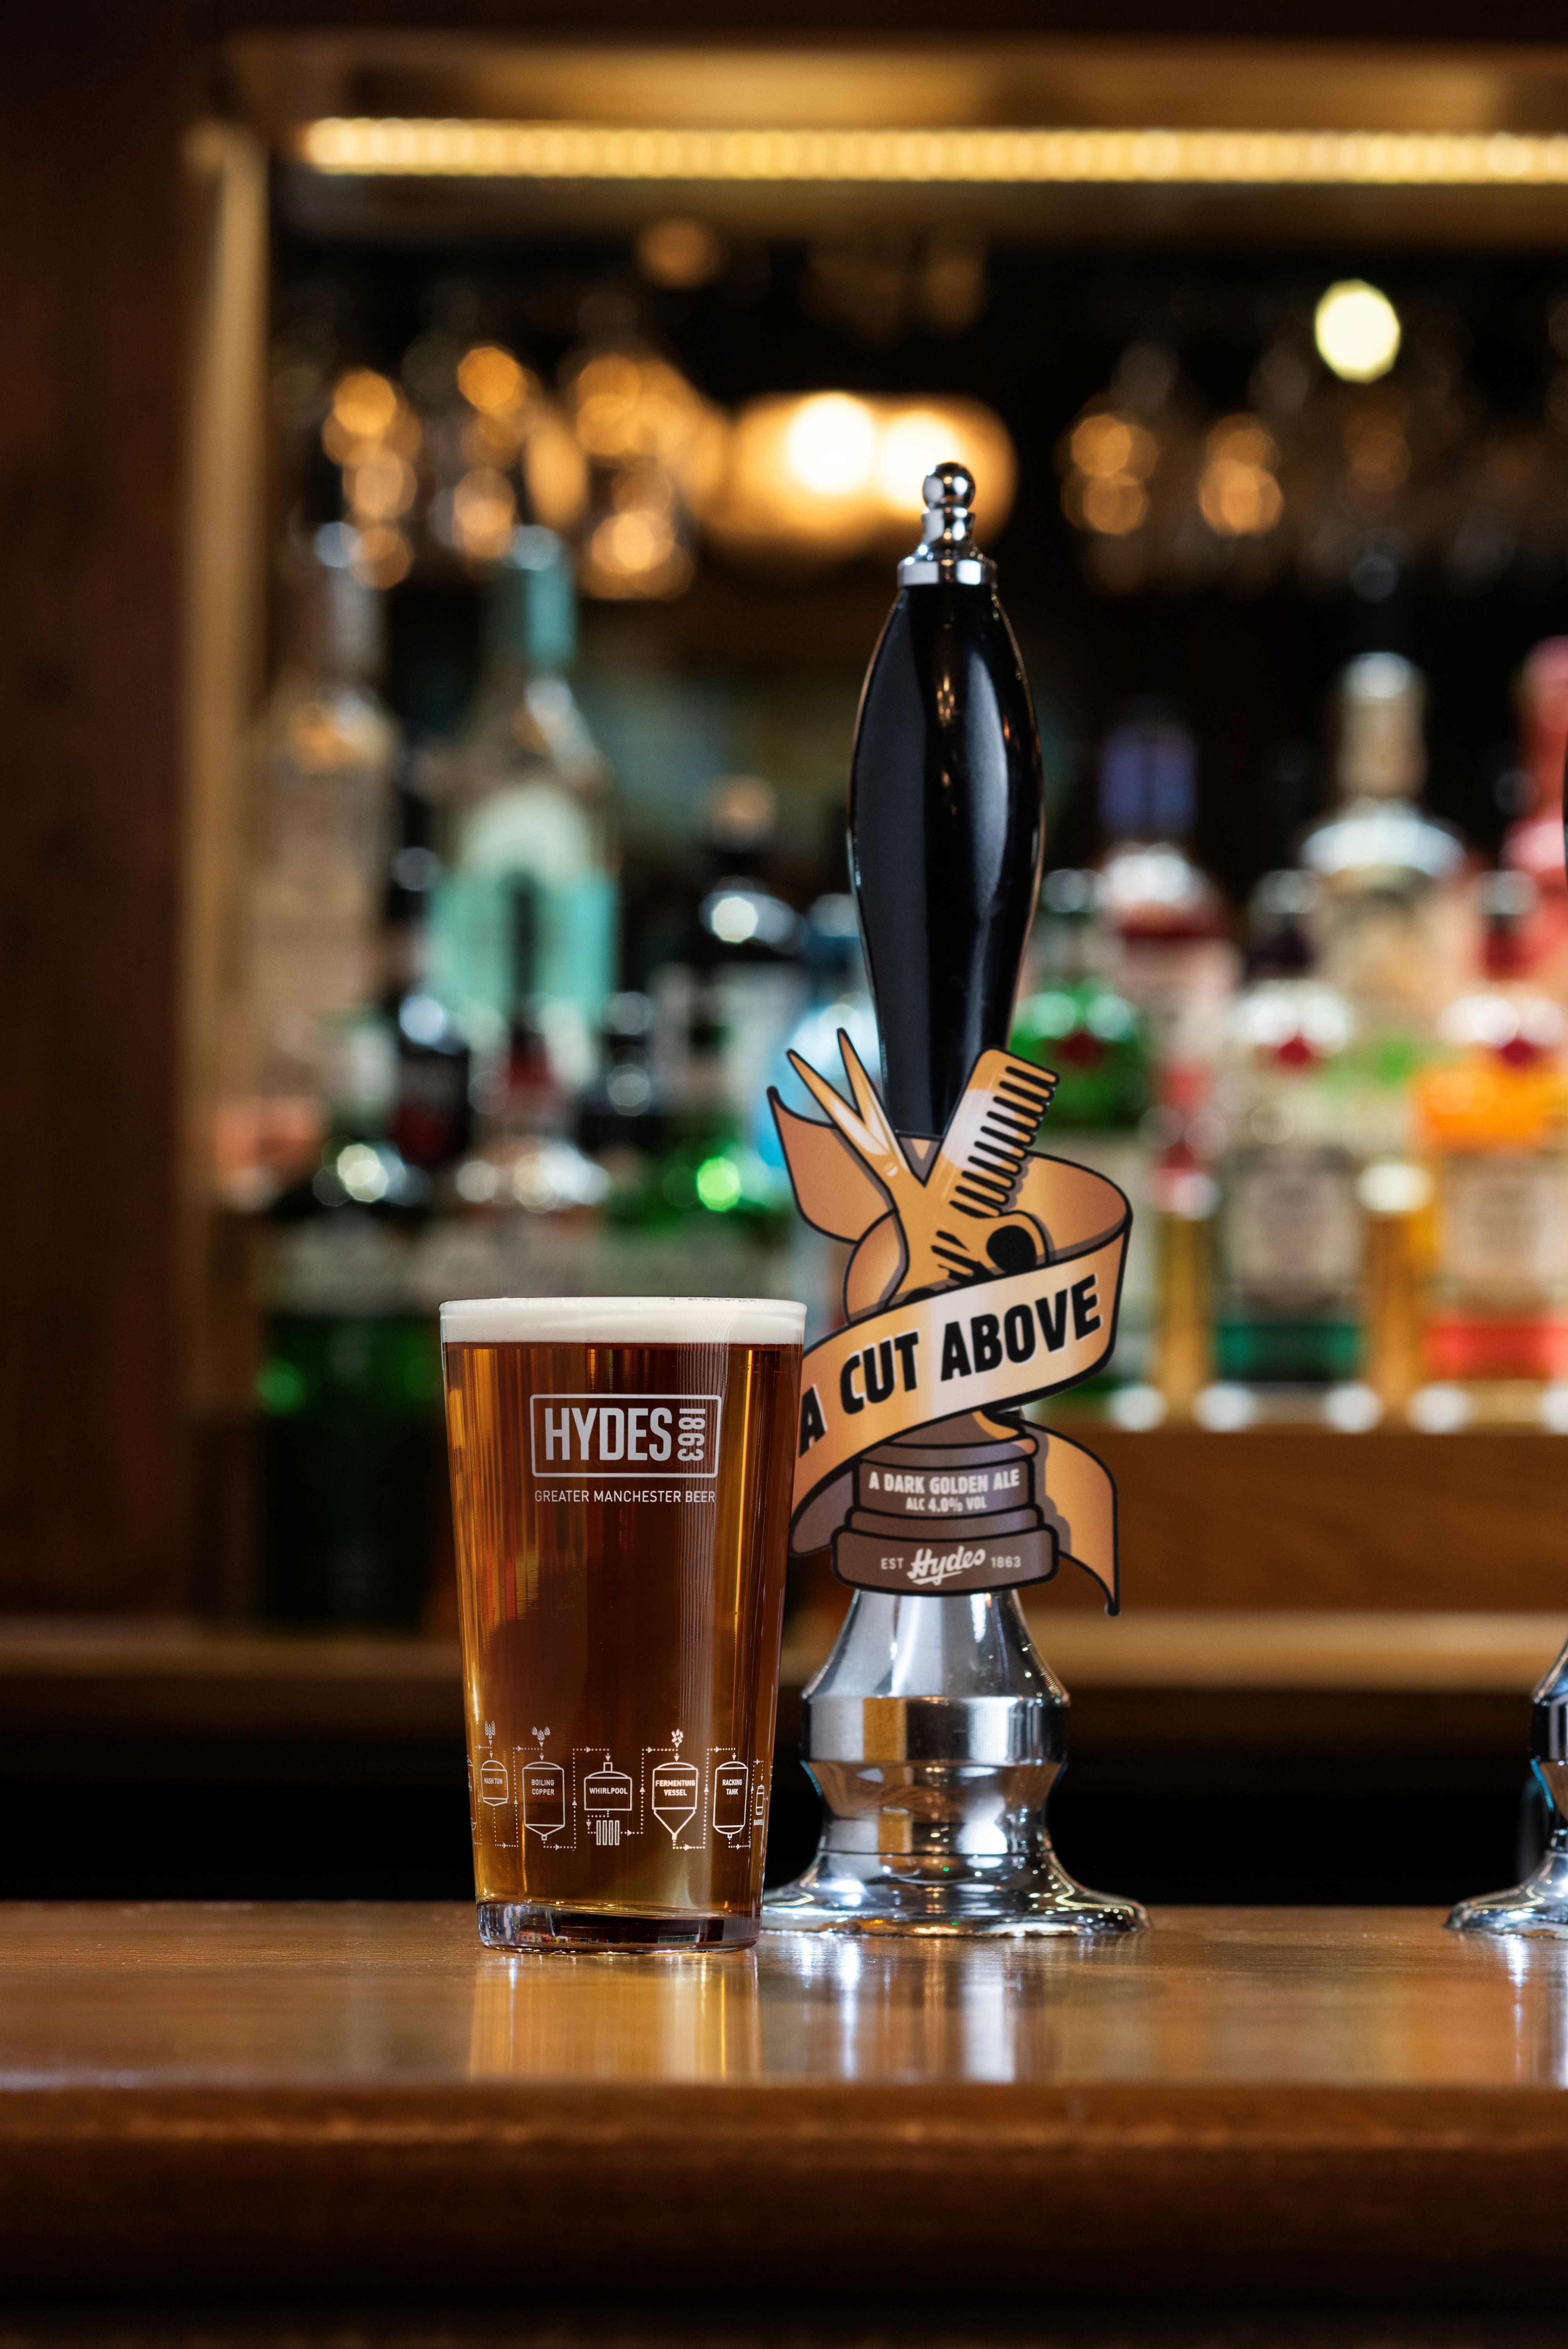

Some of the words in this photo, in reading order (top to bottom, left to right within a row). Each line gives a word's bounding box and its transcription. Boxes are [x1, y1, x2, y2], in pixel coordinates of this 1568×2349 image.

[799, 1385, 828, 1458] A
[839, 1329, 919, 1415] CUT
[940, 1273, 1102, 1381] ABOVE
[545, 1408, 672, 1461] HYDES
[678, 1408, 706, 1461] 1863
[535, 1490, 589, 1502] GREATER
[595, 1491, 681, 1502] MANCHESTER
[686, 1491, 715, 1502] BEER
[870, 1472, 879, 1489] A
[884, 1474, 925, 1494] DARK
[930, 1474, 989, 1494] GOLDEN
[992, 1469, 1019, 1491] ALE
[906, 1498, 925, 1510] ALC
[928, 1498, 963, 1512] 4.0%
[966, 1496, 987, 1510] VOL
[881, 1558, 903, 1569] EST
[907, 1546, 985, 1585] Hydes
[991, 1556, 1021, 1568] 1863
